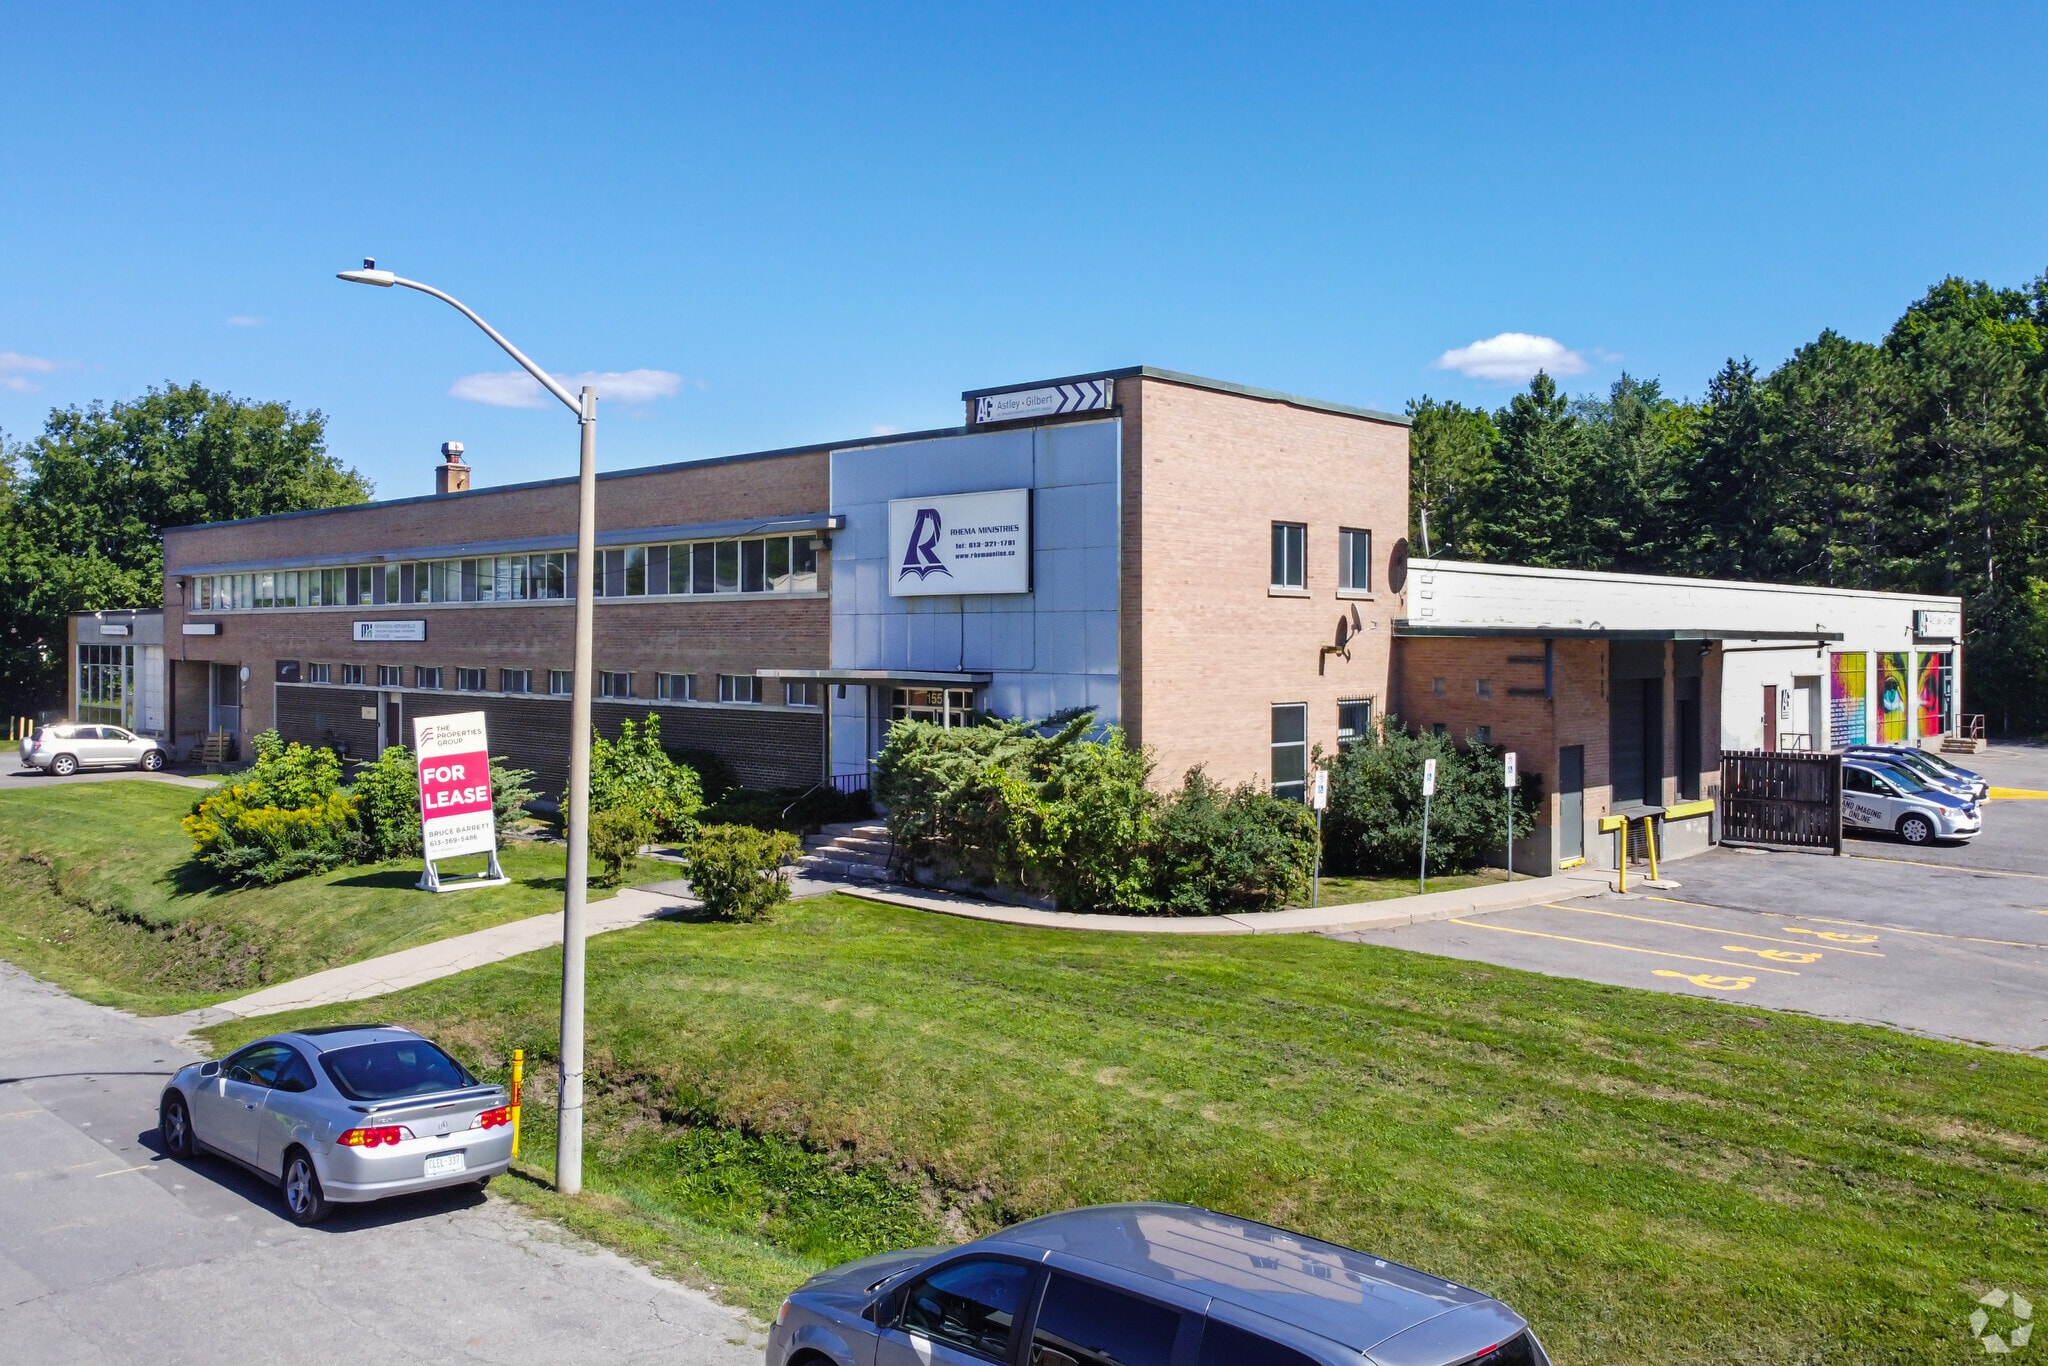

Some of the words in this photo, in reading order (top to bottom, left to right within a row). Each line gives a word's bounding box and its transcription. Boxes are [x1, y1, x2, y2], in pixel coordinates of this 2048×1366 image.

[997, 400, 1020, 411] Astley
[1025, 395, 1053, 407] Gilbert
[950, 527, 976, 537] RHEMA
[978, 524, 1020, 535] MINISTRIES
[927, 692, 943, 705] 155
[436, 728, 482, 740] PROPERTIES
[437, 737, 464, 747] GROUP
[422, 764, 466, 785] FOR
[425, 785, 489, 810] LEASE
[1842, 800, 1855, 810] AND
[1855, 804, 1882, 820] IMAGING
[428, 828, 455, 838] BRUCE
[456, 823, 490, 834] BARRETT
[429, 834, 479, 847] 613-369-5486
